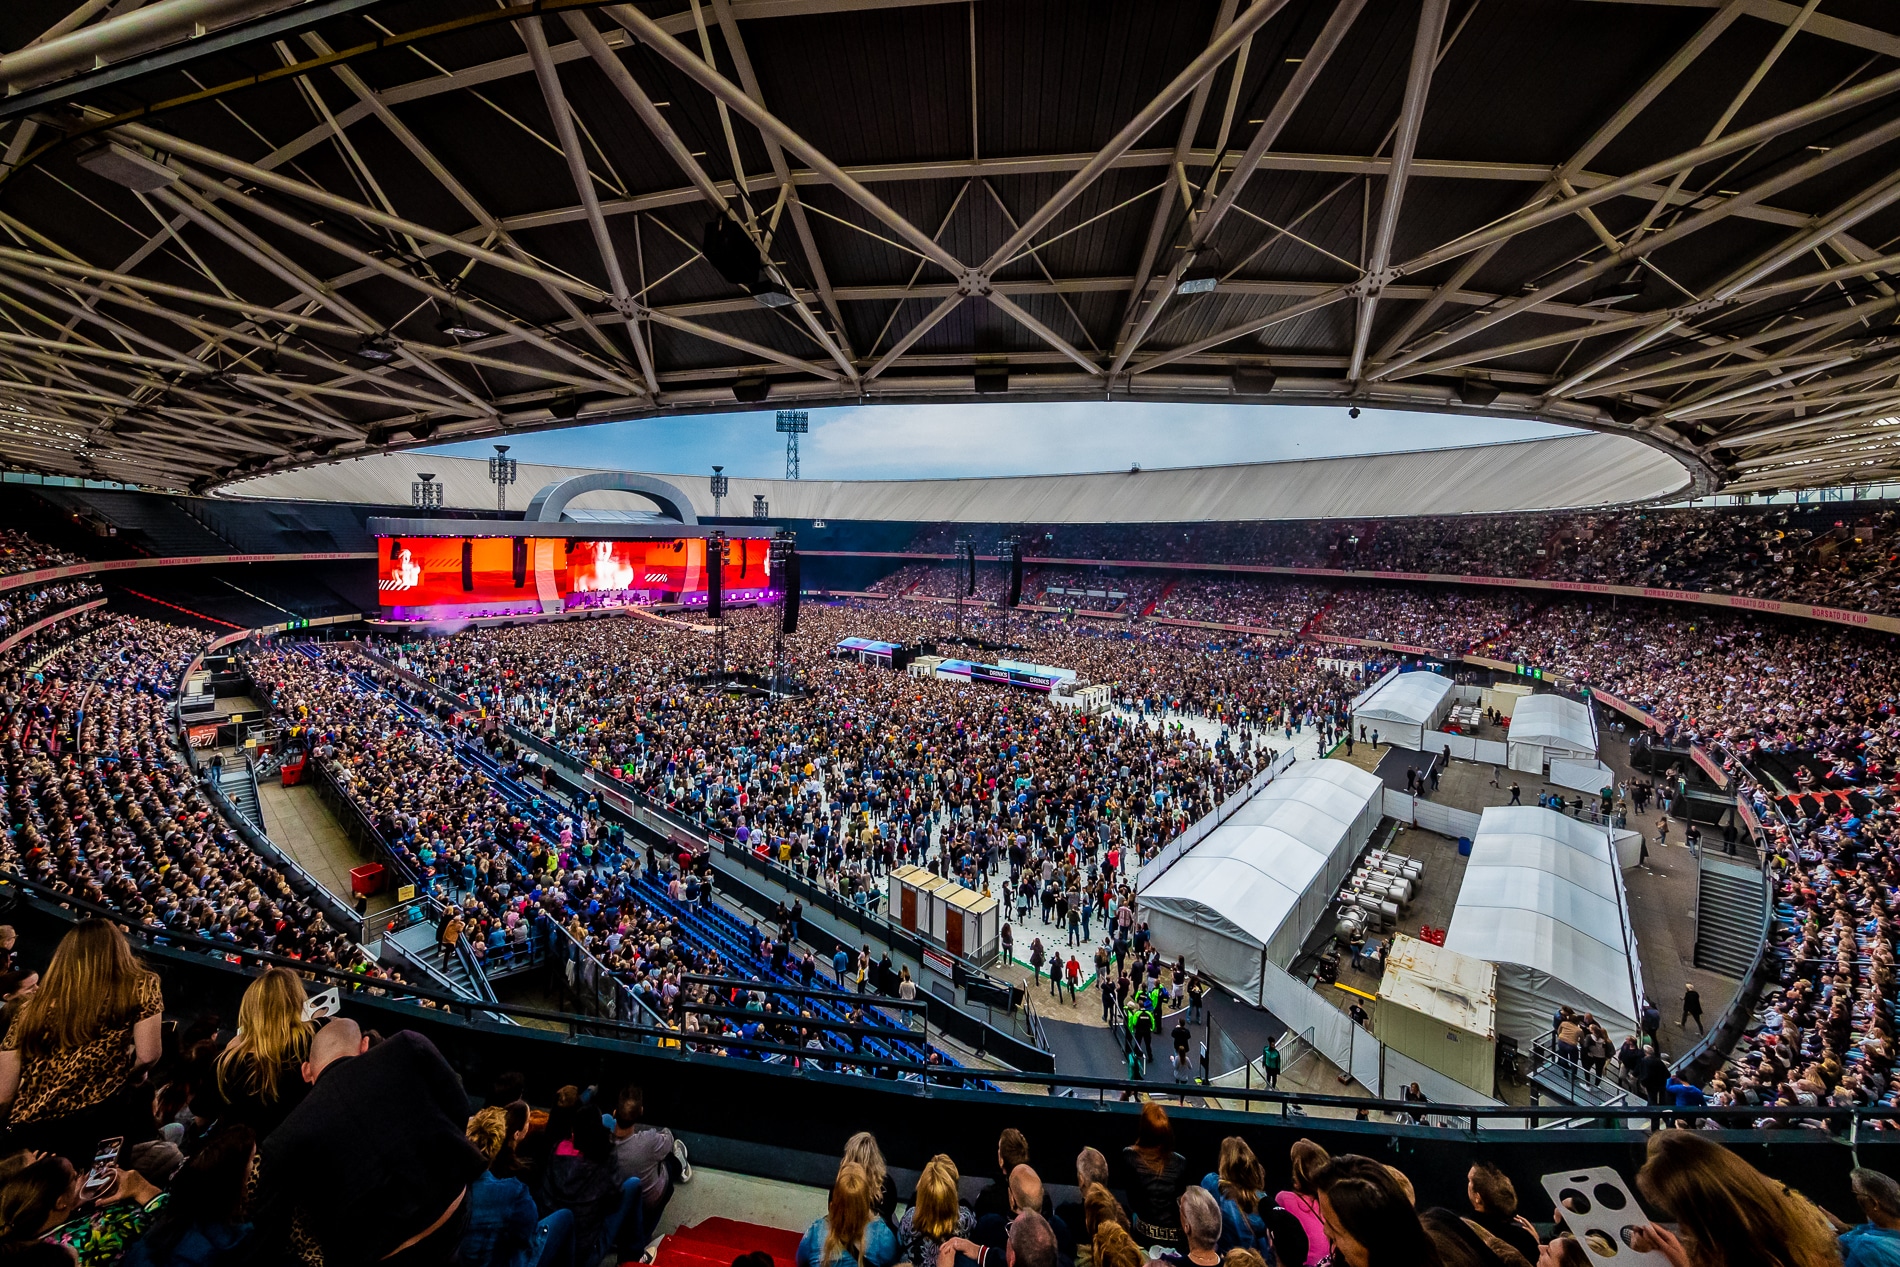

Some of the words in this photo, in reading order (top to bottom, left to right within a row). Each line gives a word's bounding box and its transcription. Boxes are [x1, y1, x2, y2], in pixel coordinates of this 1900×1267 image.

[1550, 582, 1581, 590] BORSATO
[1594, 584, 1609, 592] KUIP
[1643, 589, 1673, 598] BORSATO
[1685, 592, 1700, 600] KUIP
[1731, 597, 1756, 608] BORSATO
[1758, 601, 1765, 609] DE
[1812, 608, 1840, 620] BORSATO
[1842, 613, 1850, 621] DE
[1852, 614, 1868, 624] KUIP
[1392, 645, 1421, 653] BORSATO
[989, 669, 1008, 678] DRINKS
[1029, 676, 1050, 686] DRINKS
[190, 733, 216, 747] 27
